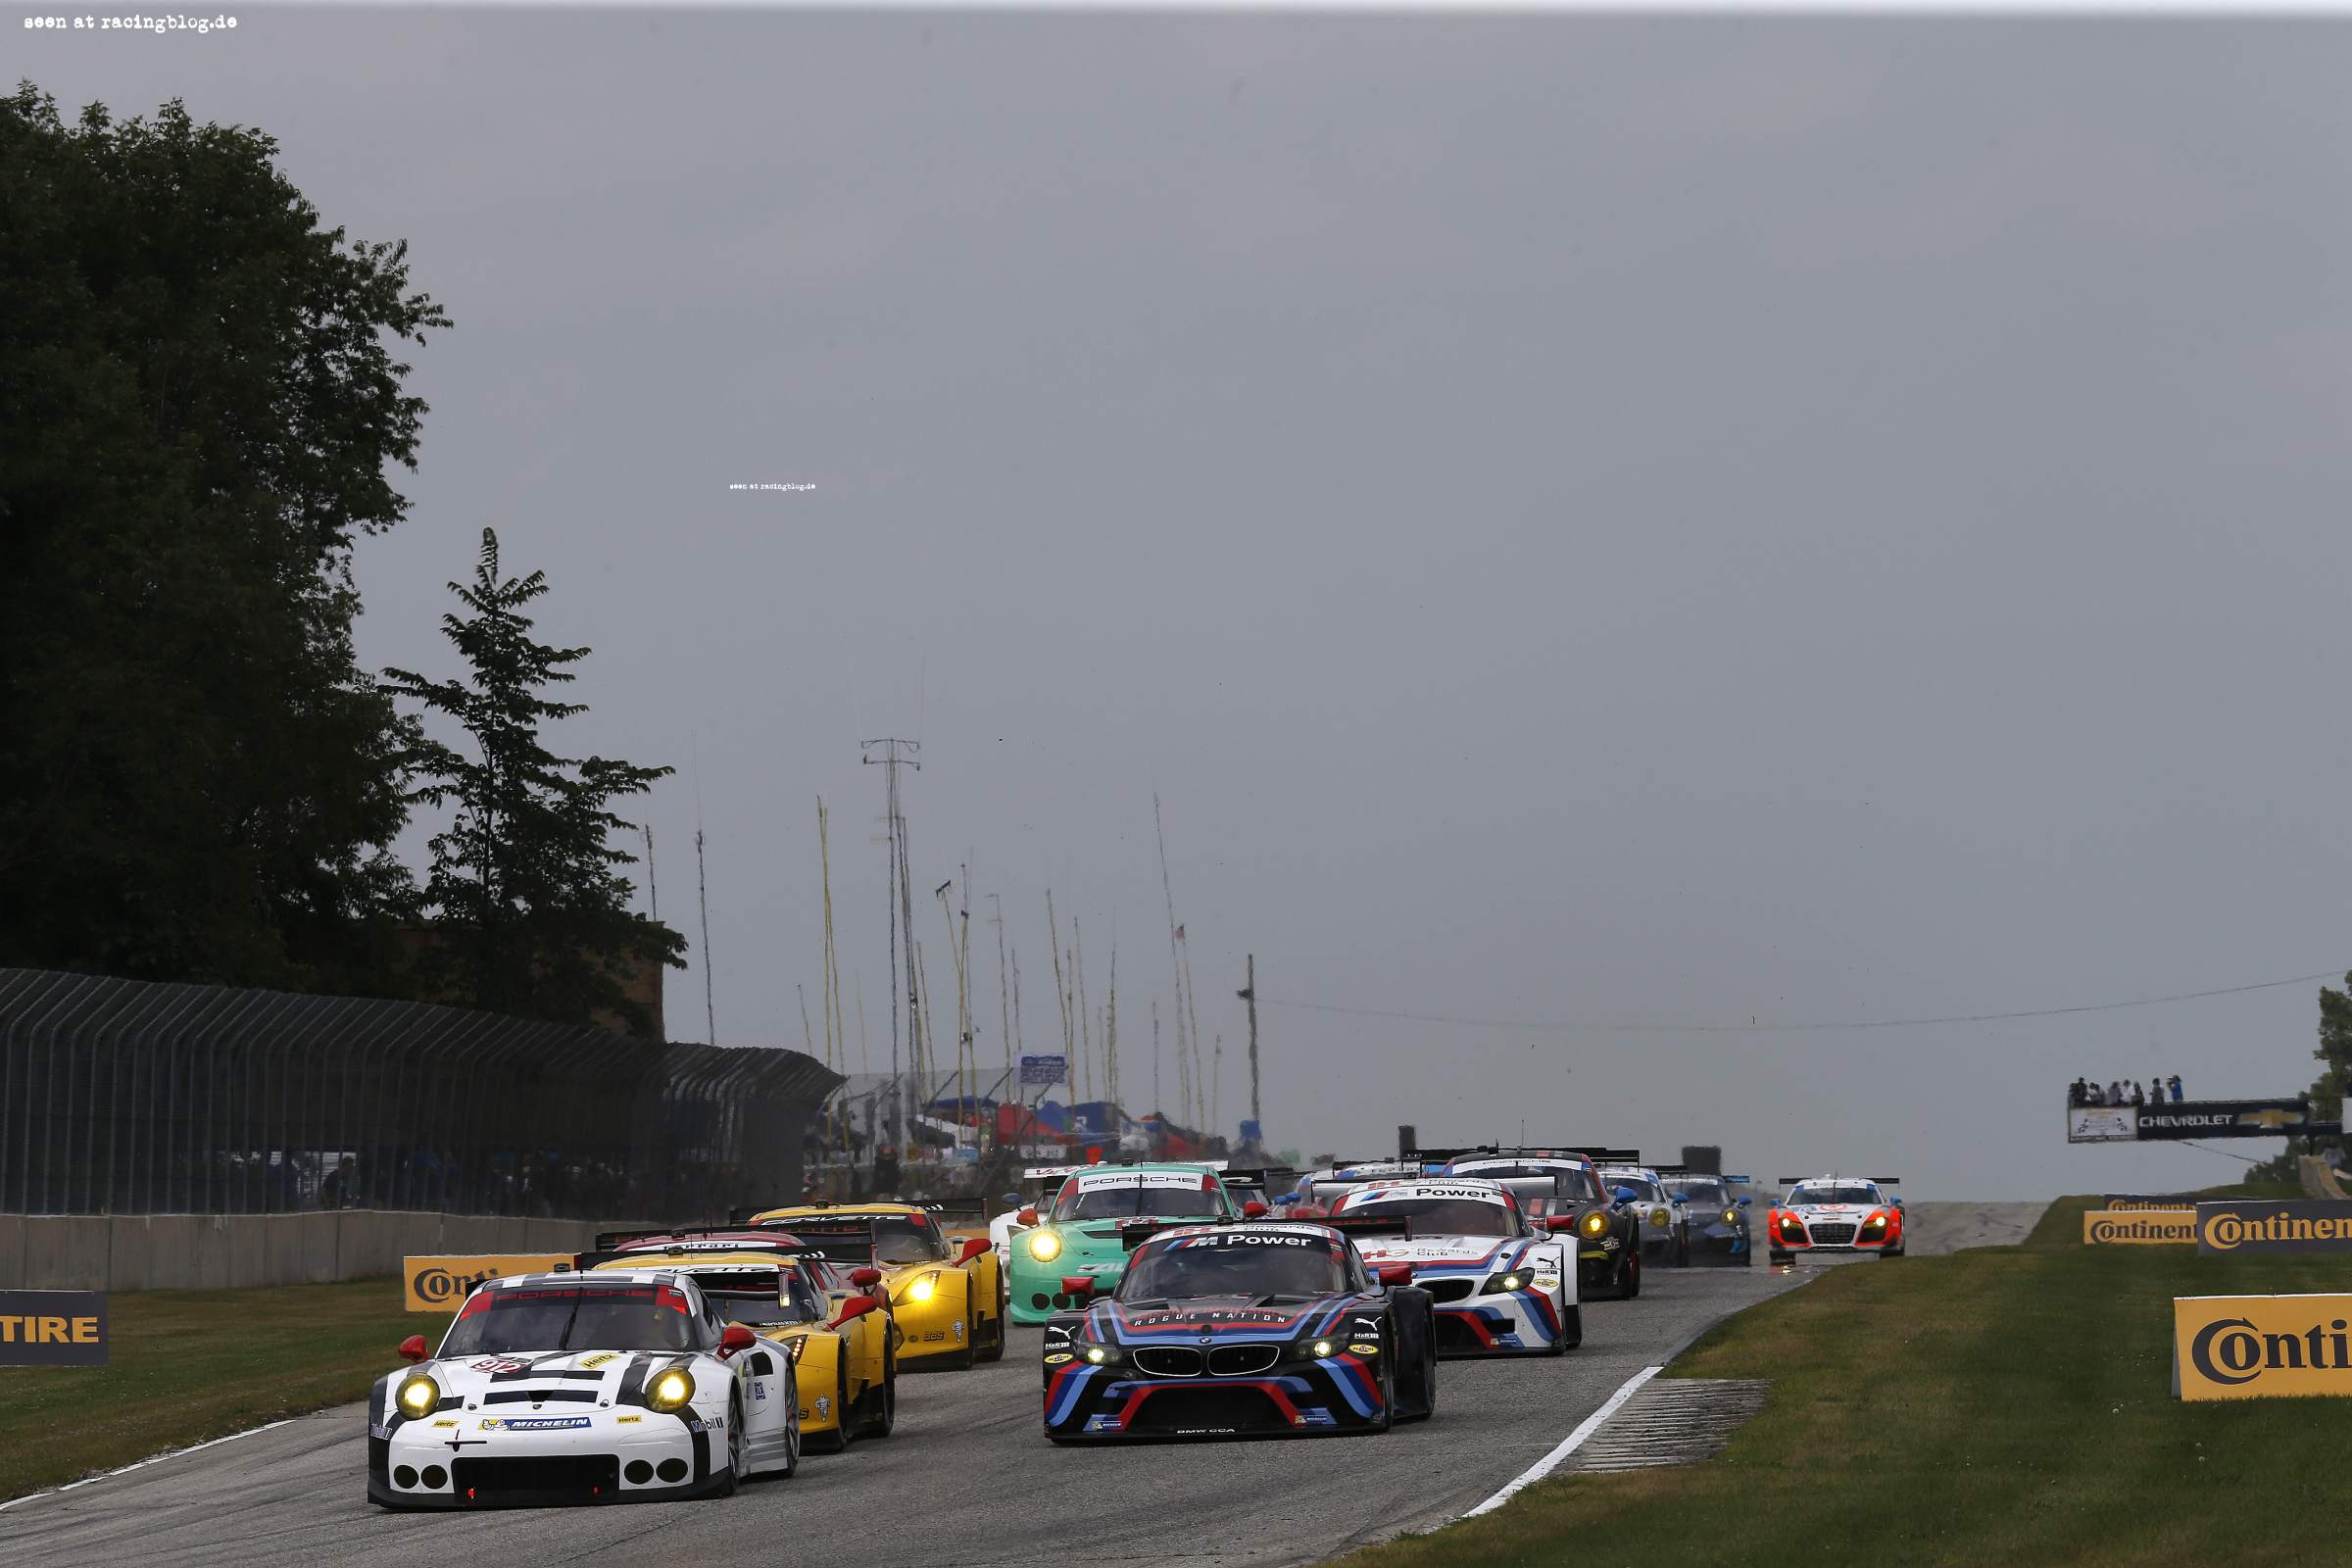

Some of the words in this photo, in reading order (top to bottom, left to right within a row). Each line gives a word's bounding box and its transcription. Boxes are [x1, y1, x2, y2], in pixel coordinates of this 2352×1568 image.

[2139, 1115, 2232, 1127] CHEVROLET
[1084, 1177, 1198, 1187] PORSCHE
[1416, 1189, 1488, 1198] Power
[761, 1215, 907, 1226] CORVETTE
[1227, 1235, 1311, 1246] Power
[414, 1268, 499, 1303] Con
[497, 1289, 653, 1301] PORSCHE
[1134, 1314, 1196, 1326] ROGUE
[1211, 1312, 1286, 1323] NATION
[0, 1316, 99, 1343] TIRE
[2192, 1317, 2352, 1385] Conti
[479, 1358, 522, 1373] 912
[584, 1353, 614, 1368] Hertz
[512, 1418, 588, 1428] MICHELIN
[692, 1419, 715, 1433] Mobil
